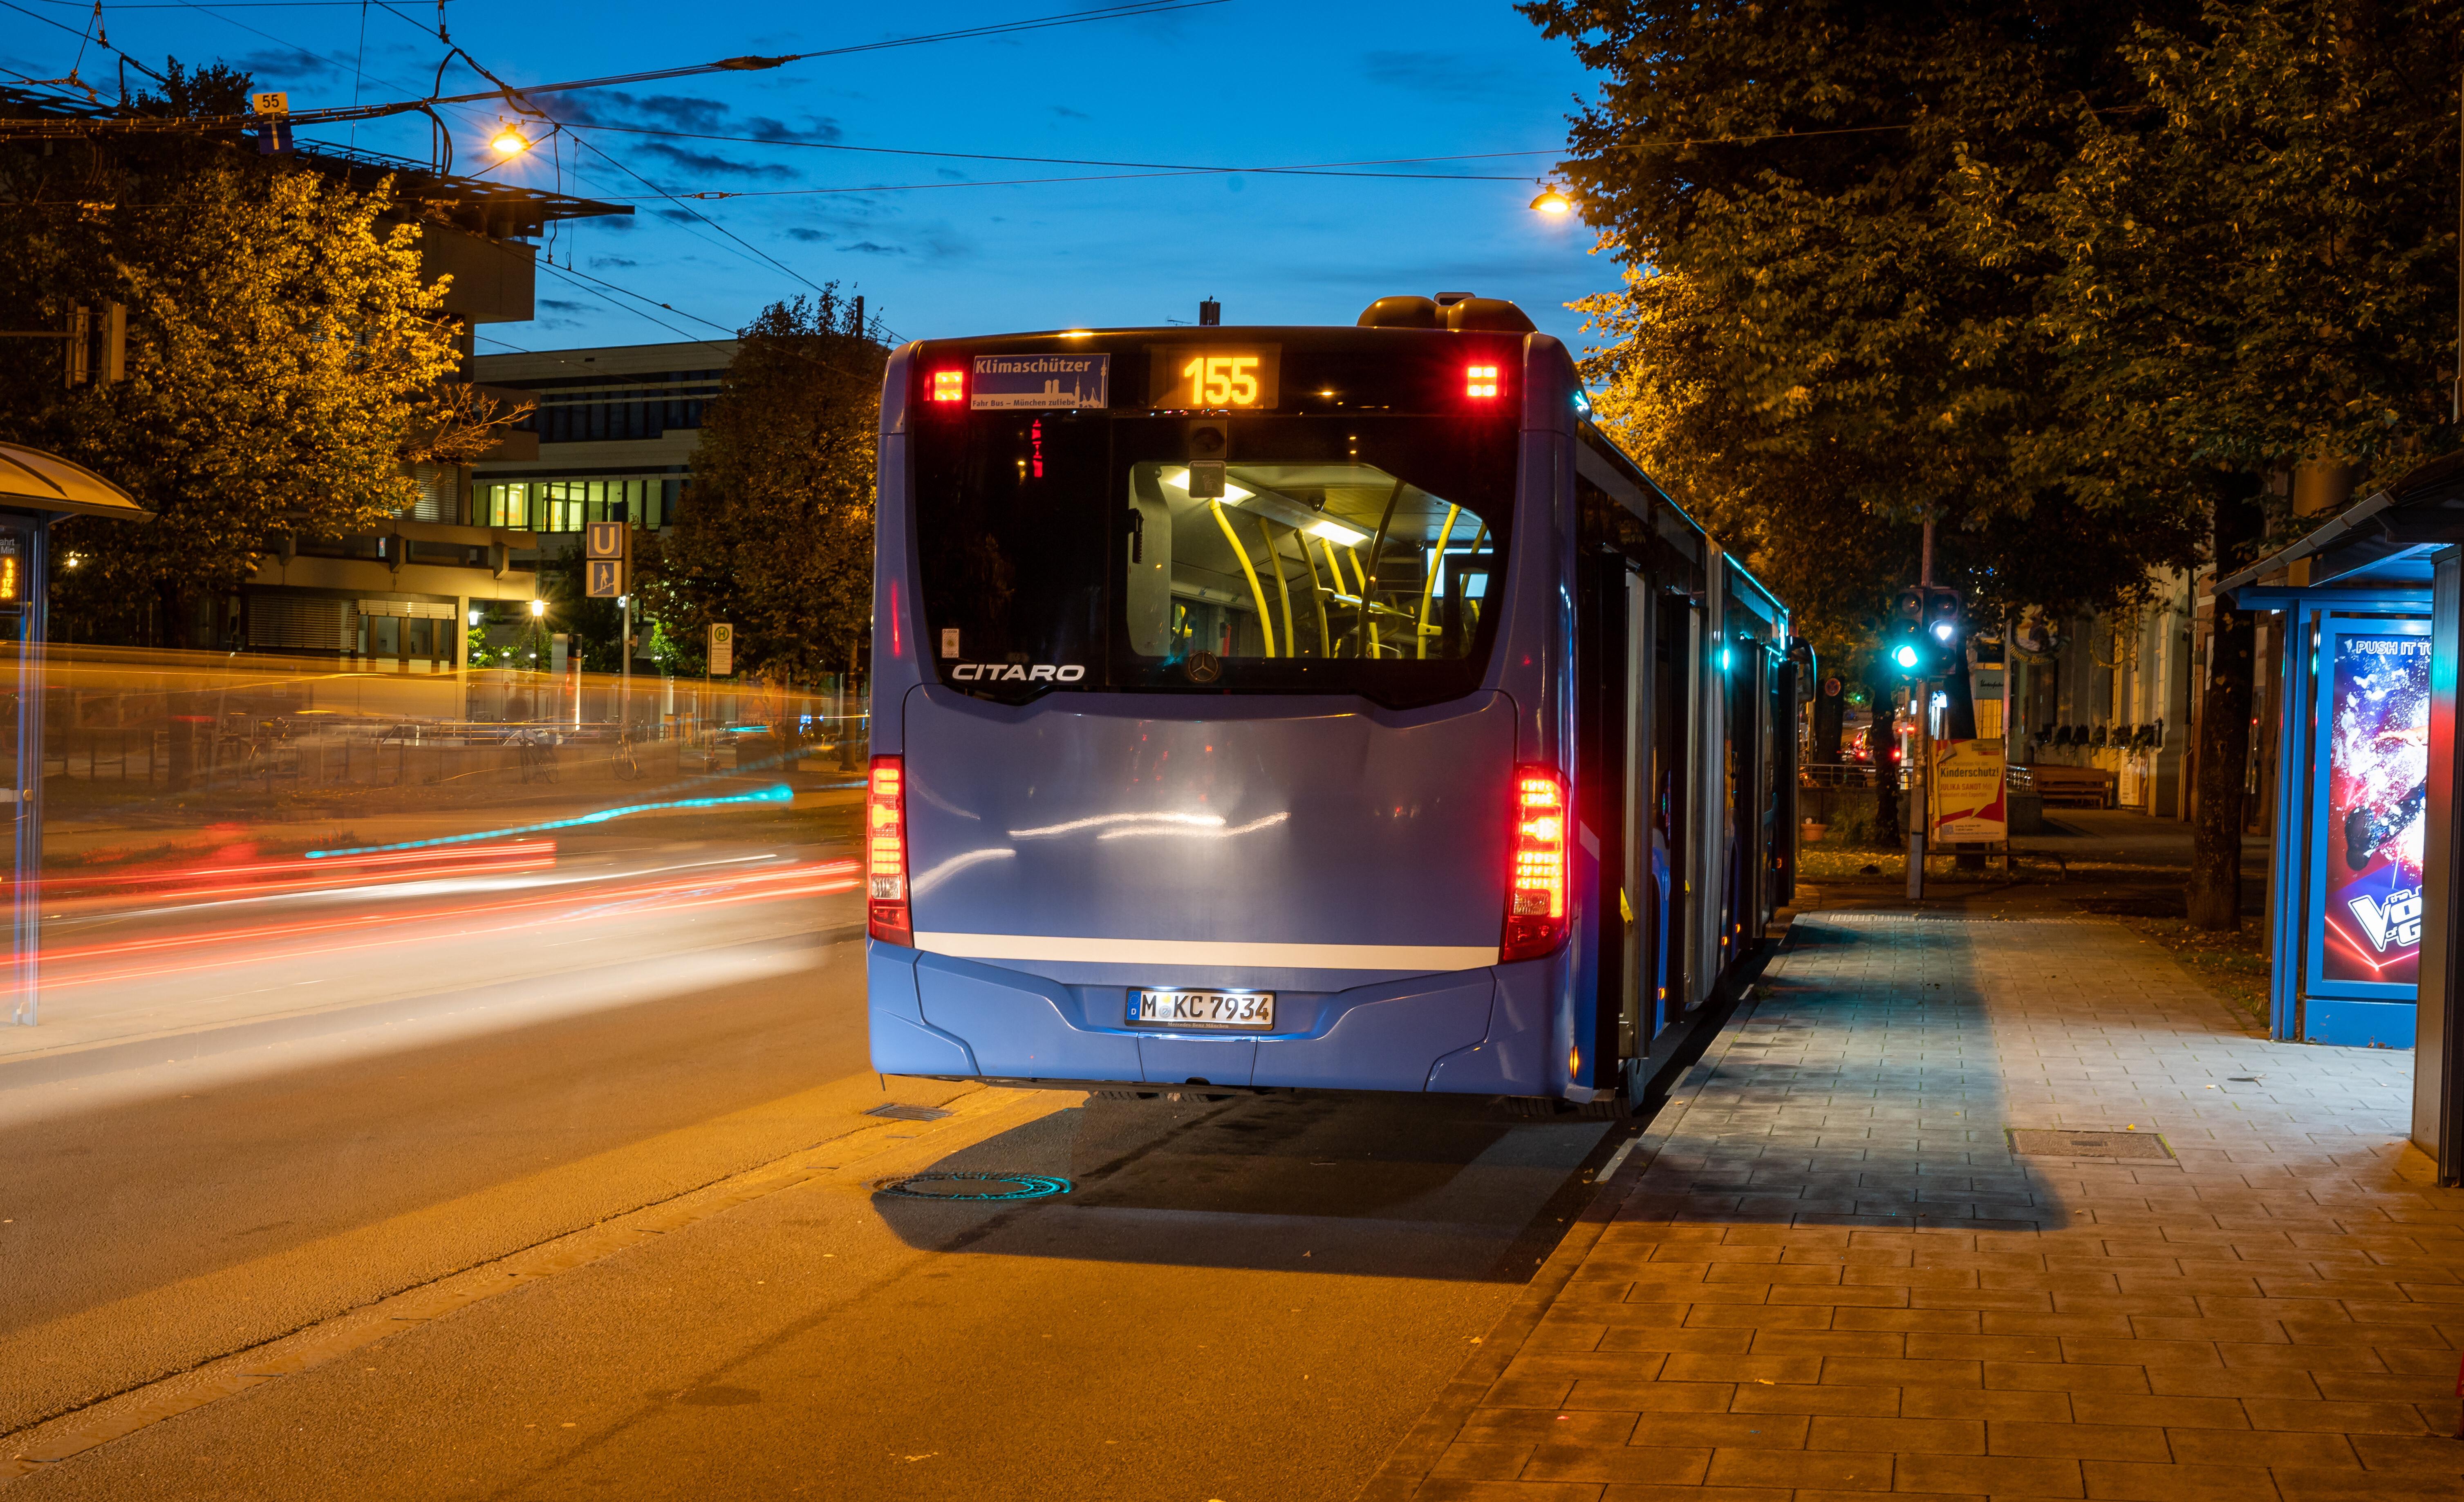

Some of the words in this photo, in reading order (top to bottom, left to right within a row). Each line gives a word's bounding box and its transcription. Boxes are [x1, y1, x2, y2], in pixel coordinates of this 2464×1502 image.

[263, 94, 279, 108] 55
[975, 358, 1091, 374] Klimaschützer
[1184, 357, 1258, 405] 155
[594, 527, 615, 554] U
[1, 546, 15, 554] Min
[3, 578, 13, 587] 17
[2356, 641, 2397, 655] PUSH
[2401, 641, 2416, 655] IT
[952, 664, 1085, 682] CITARO
[1940, 766, 1999, 777] Kinderschutz!
[2386, 927, 2399, 939] of
[1142, 995, 1156, 1017] M
[1174, 995, 1203, 1018] KC
[1210, 997, 1269, 1020] 7934
